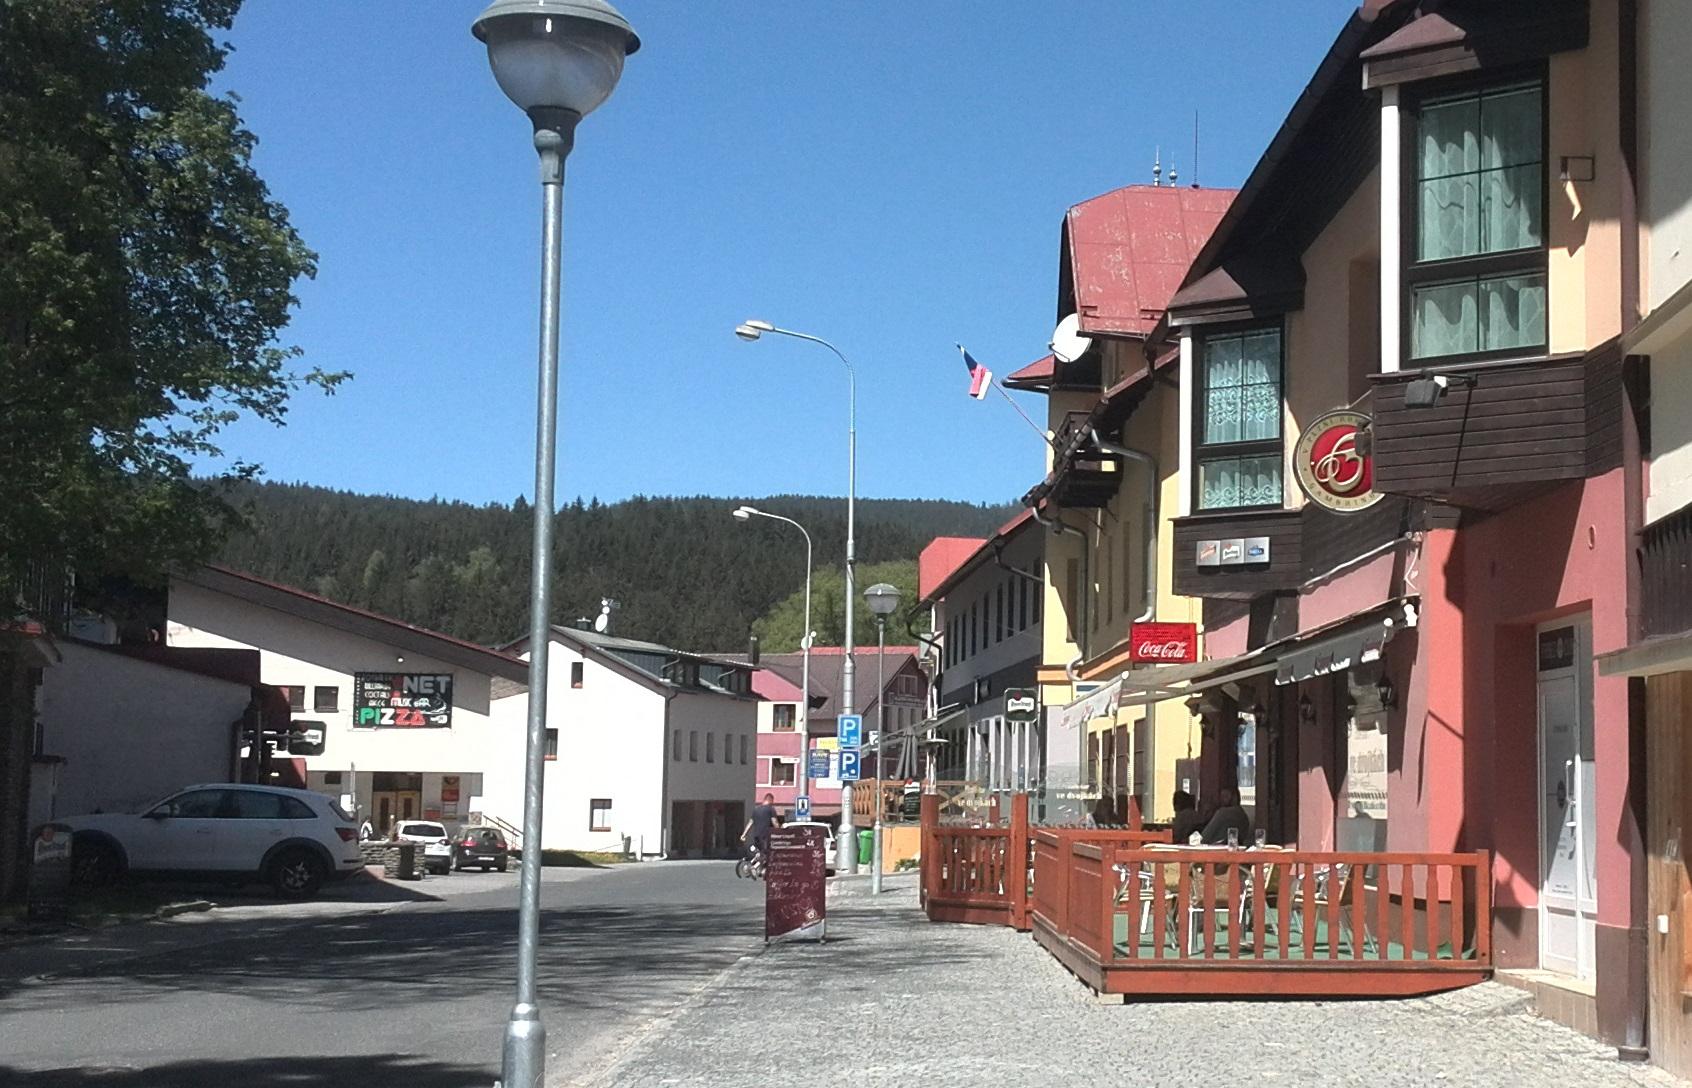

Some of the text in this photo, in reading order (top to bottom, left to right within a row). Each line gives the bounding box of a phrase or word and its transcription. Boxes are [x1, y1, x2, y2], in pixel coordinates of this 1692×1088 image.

[1138, 641, 1188, 659] Coca-Cola
[360, 707, 426, 726] PIZZA
[842, 719, 856, 736] P
[842, 752, 856, 771] P
